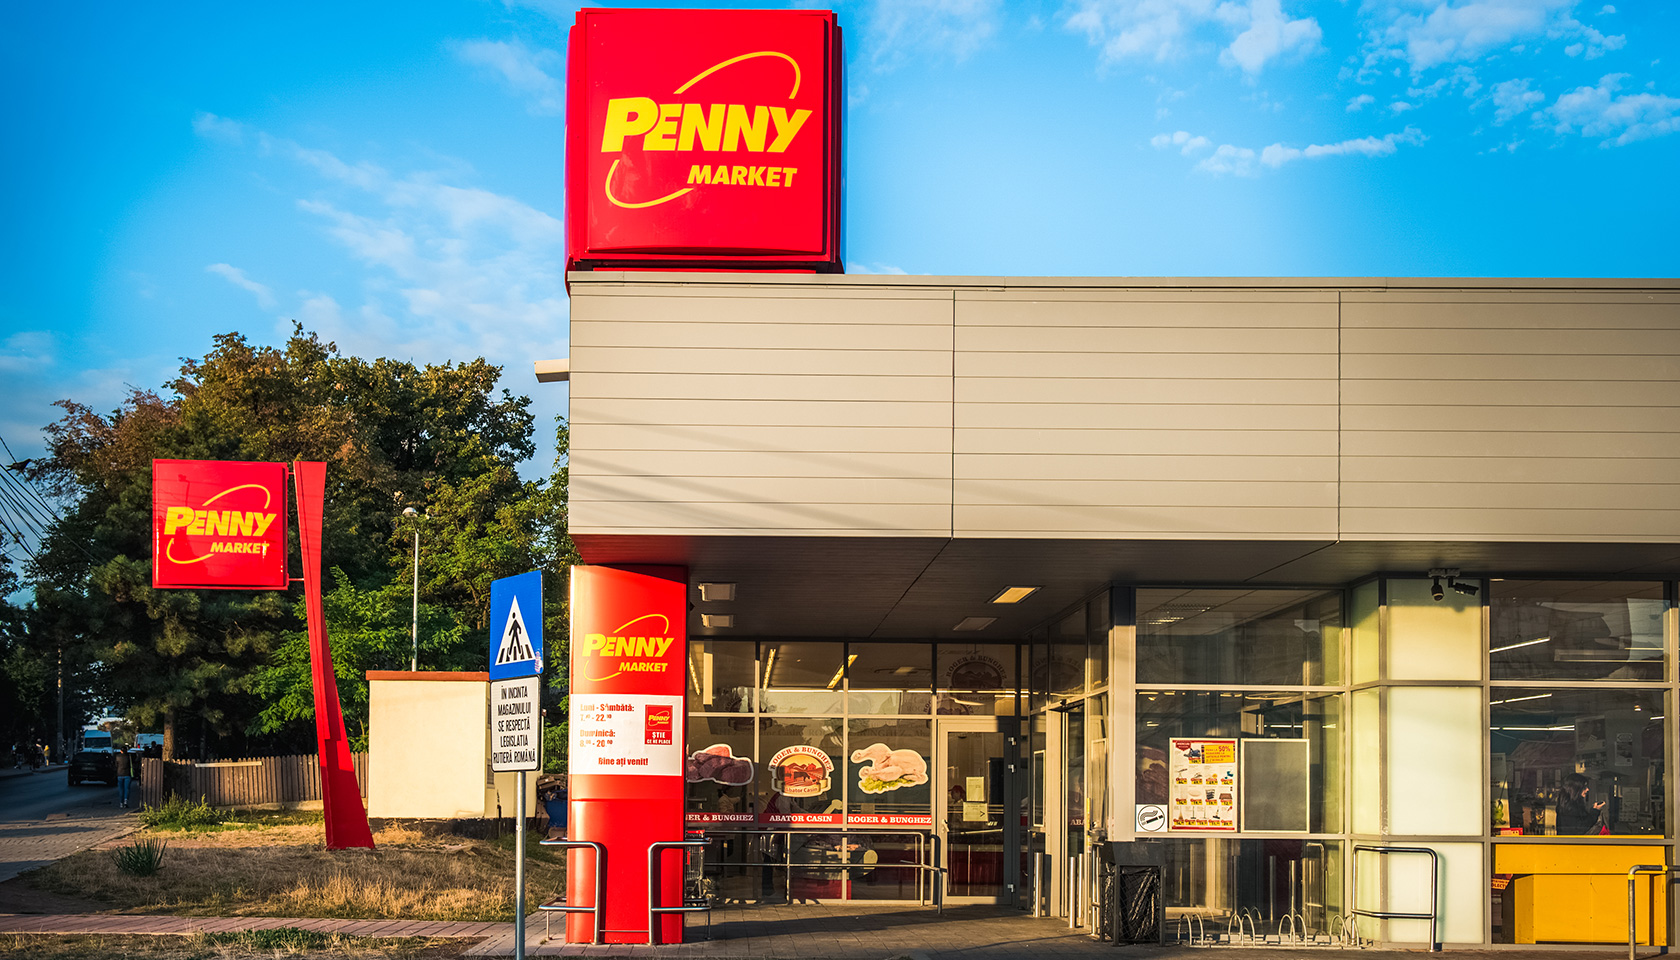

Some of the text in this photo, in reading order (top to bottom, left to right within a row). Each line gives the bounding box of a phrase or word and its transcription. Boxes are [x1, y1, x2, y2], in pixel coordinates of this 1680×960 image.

[601, 97, 813, 153] PENNY
[687, 165, 798, 187] MARKET
[164, 506, 277, 536] PENNY
[210, 542, 270, 554] MARKET
[582, 633, 675, 657] PENNY
[618, 662, 668, 672] MARKET
[498, 702, 531, 716] MAGAZINULUI
[498, 716, 530, 732] SE RESPECTĂ
[598, 757, 615, 765] Bine
[802, 746, 832, 770] BUNGHEZ
